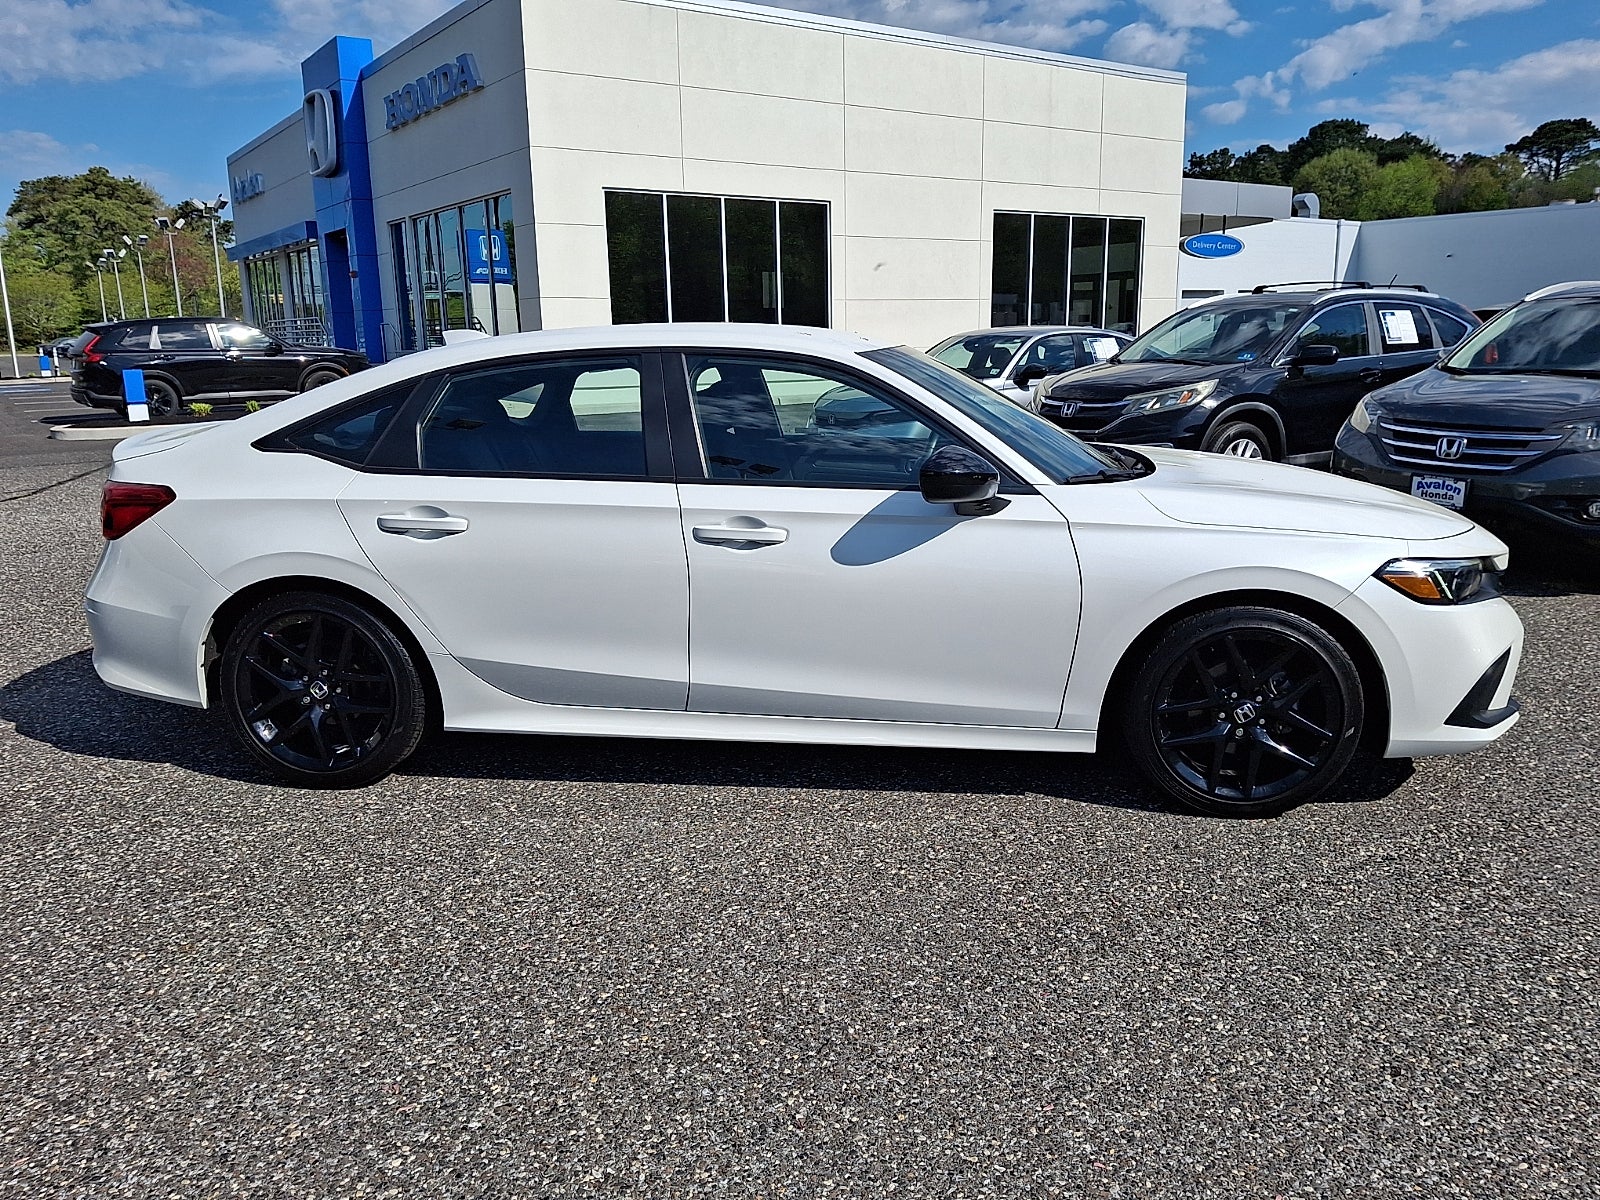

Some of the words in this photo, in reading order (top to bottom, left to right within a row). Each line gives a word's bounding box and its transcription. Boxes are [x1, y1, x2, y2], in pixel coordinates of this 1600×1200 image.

[383, 53, 484, 130] HONDA
[1192, 240, 1216, 251] Delivery
[1217, 241, 1237, 250] Center
[1416, 480, 1462, 496] Avalon
[1421, 490, 1455, 501] Honda
